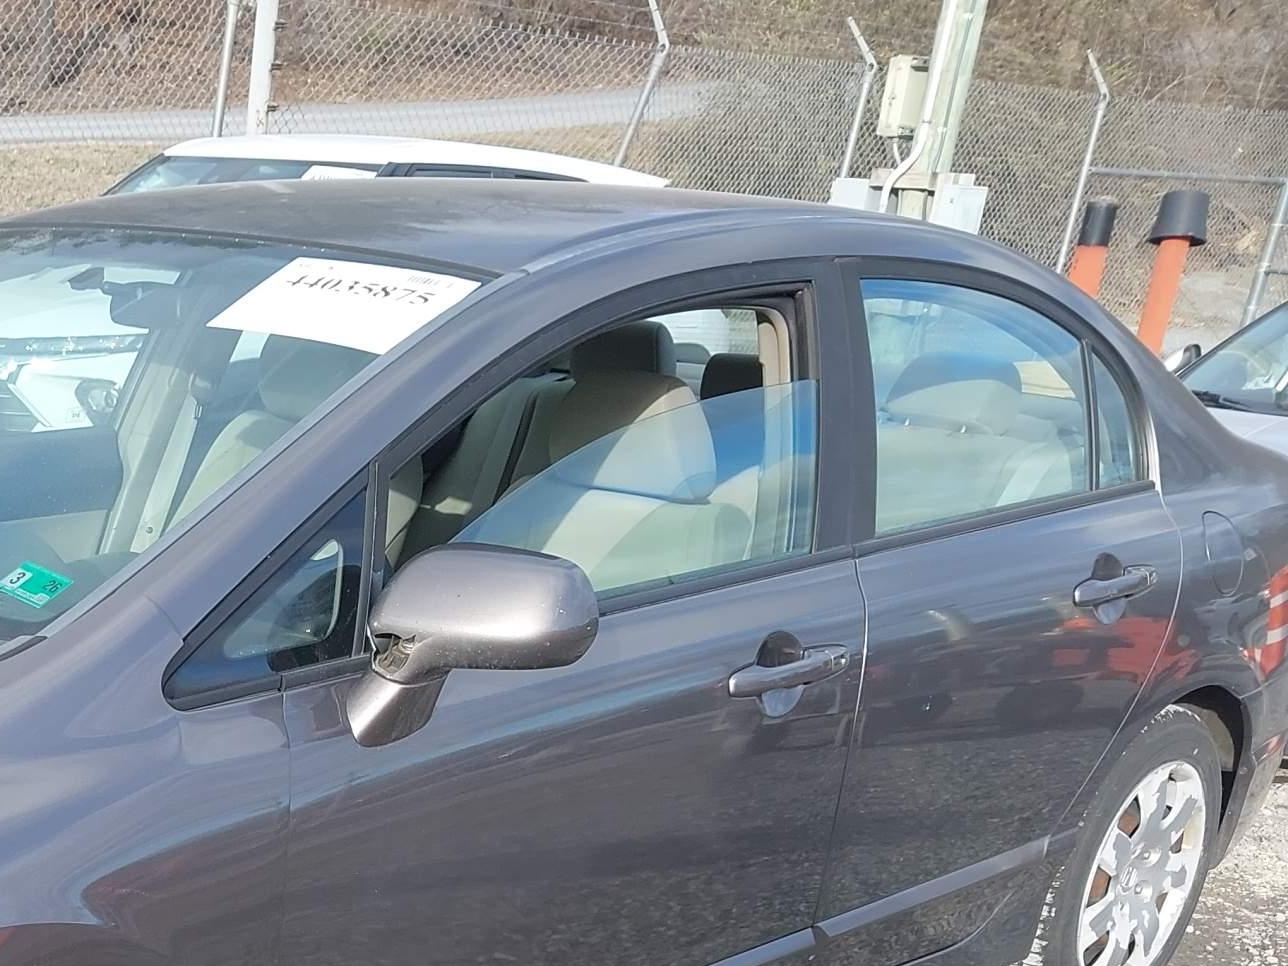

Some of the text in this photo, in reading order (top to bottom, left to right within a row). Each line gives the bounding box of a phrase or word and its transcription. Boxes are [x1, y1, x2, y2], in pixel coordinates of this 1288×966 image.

[286, 274, 436, 304] 44035875
[9, 572, 26, 585] 3
[43, 580, 63, 593] 26
